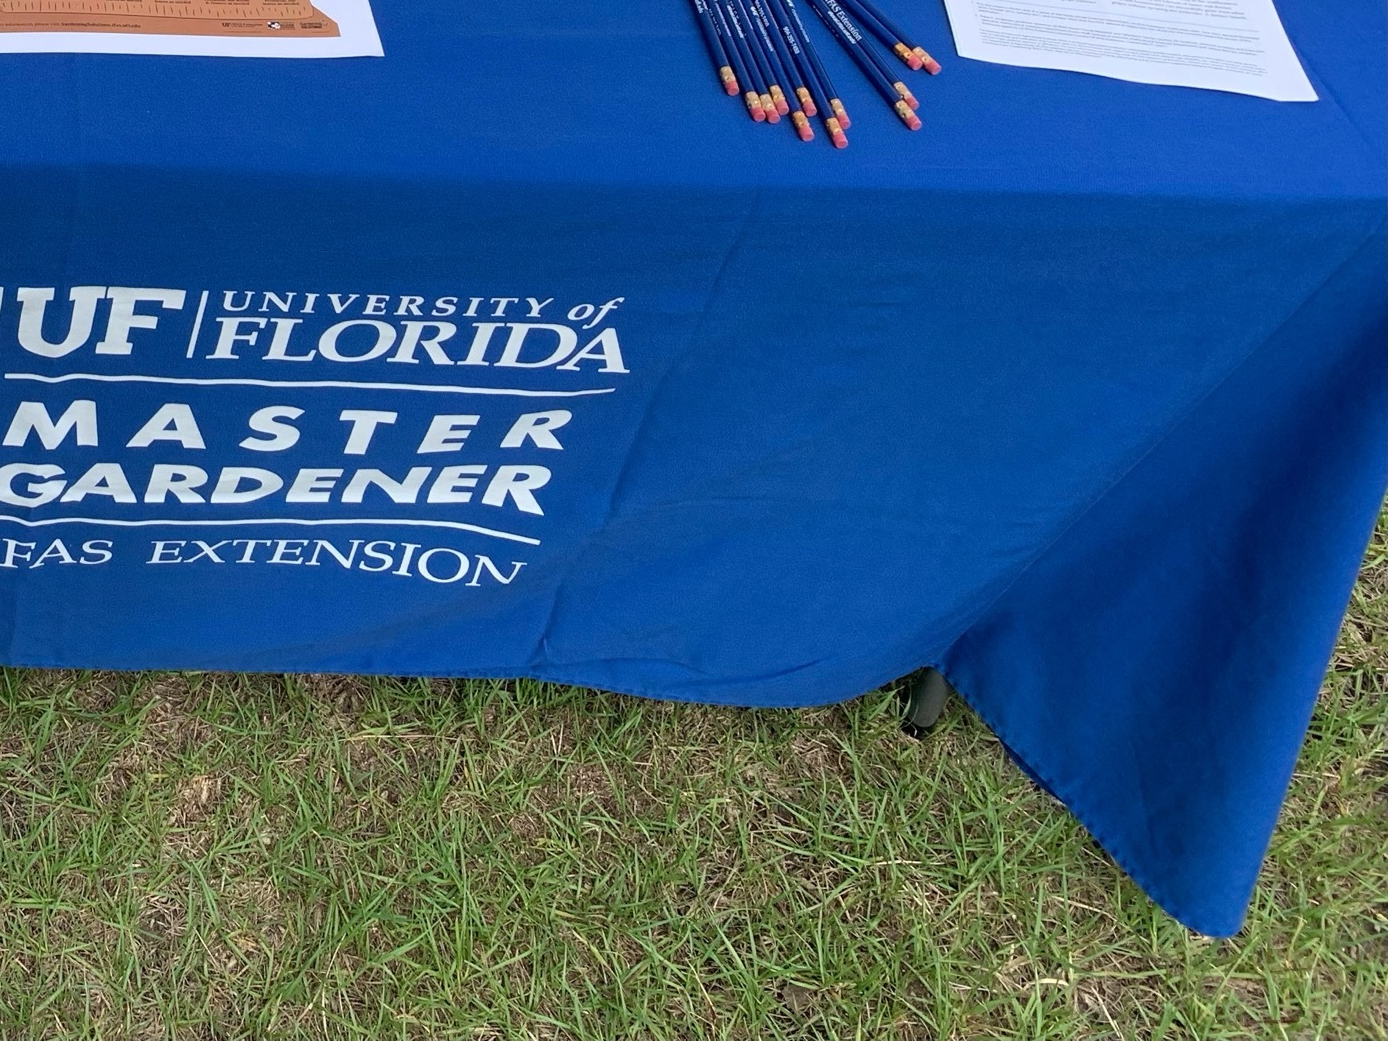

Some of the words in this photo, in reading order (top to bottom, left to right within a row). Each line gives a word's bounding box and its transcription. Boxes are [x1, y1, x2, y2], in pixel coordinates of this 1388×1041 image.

[837, 11, 862, 41] Extension
[16, 286, 187, 359] UF
[222, 290, 554, 319] UNIVERSITY
[567, 297, 624, 328] of
[206, 317, 630, 374] FLORIDA
[2, 399, 574, 455] MASTER
[147, 539, 527, 588] EXTENSION
